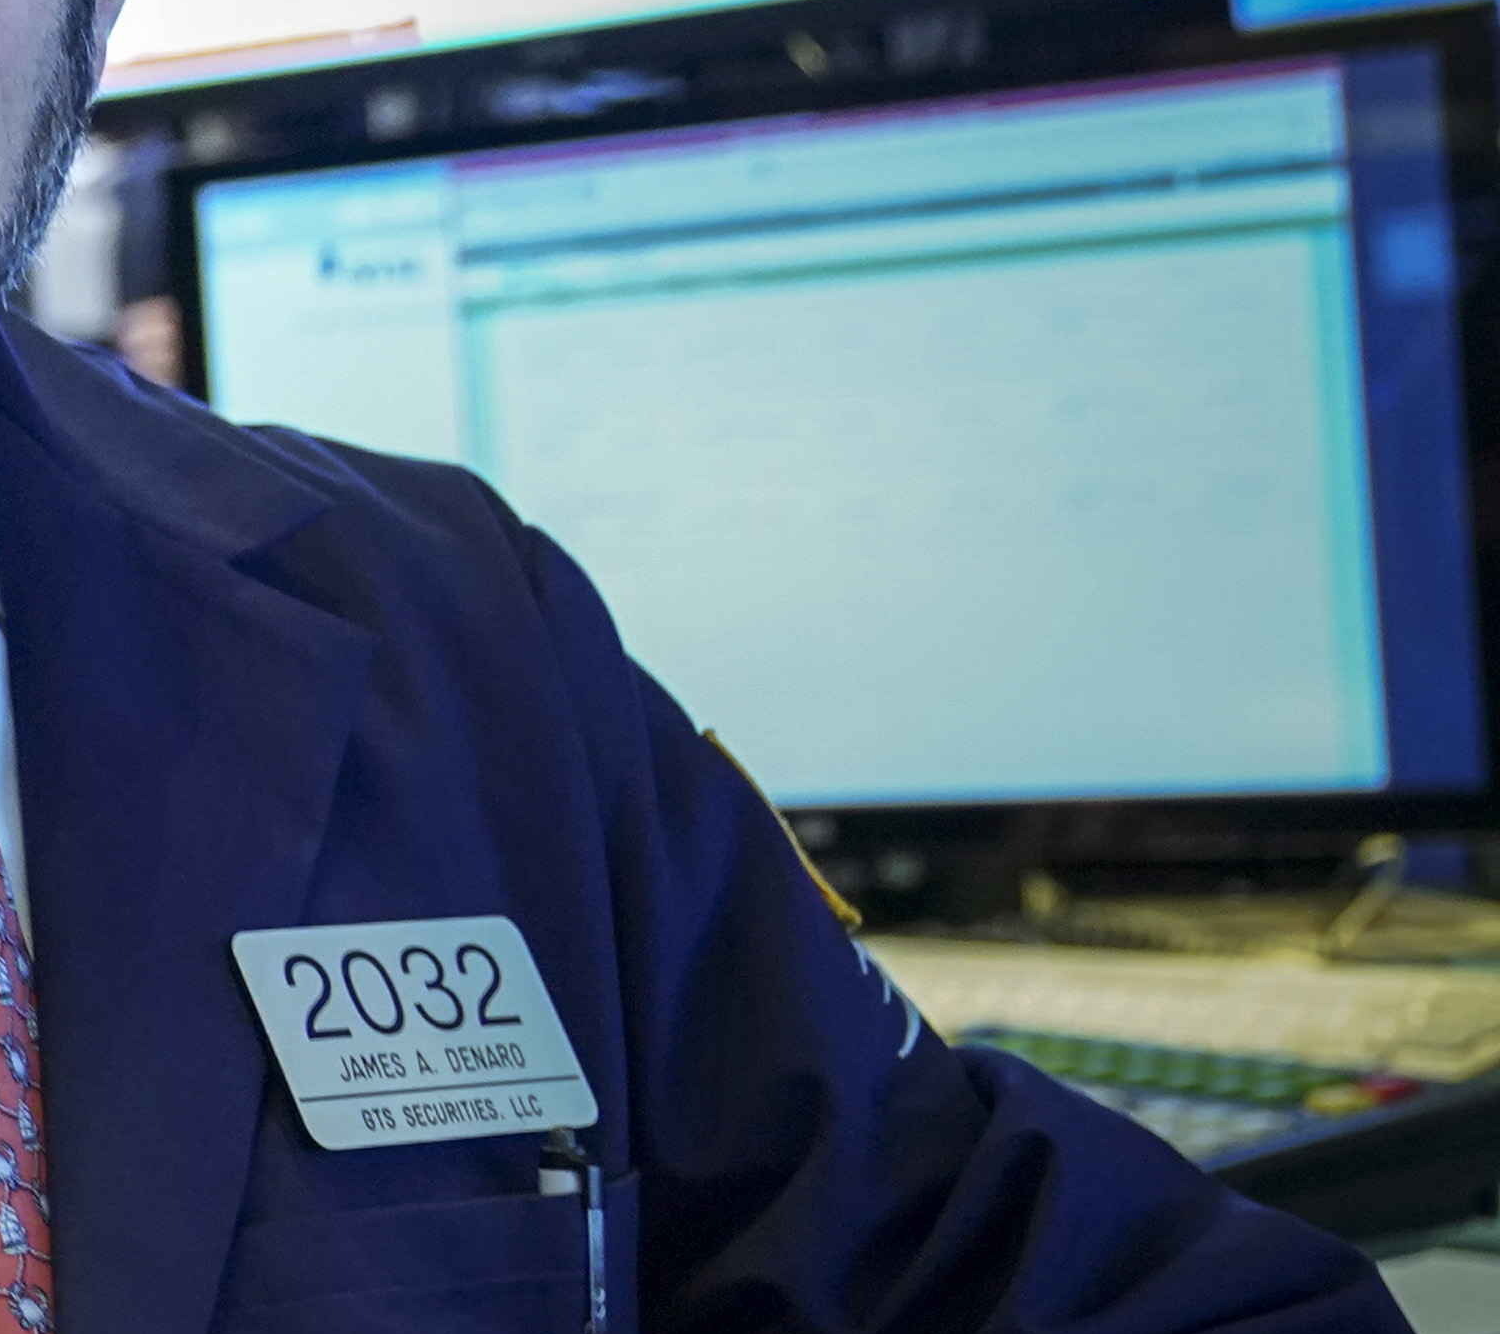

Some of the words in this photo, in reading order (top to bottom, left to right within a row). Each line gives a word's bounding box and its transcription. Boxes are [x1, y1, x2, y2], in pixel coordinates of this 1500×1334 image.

[284, 943, 522, 1041] 2032
[340, 1050, 407, 1083] JAMES
[416, 1050, 438, 1076] A.
[445, 1042, 526, 1074] DENARO
[361, 1105, 397, 1133] GTS
[510, 1094, 543, 1119] LLC
